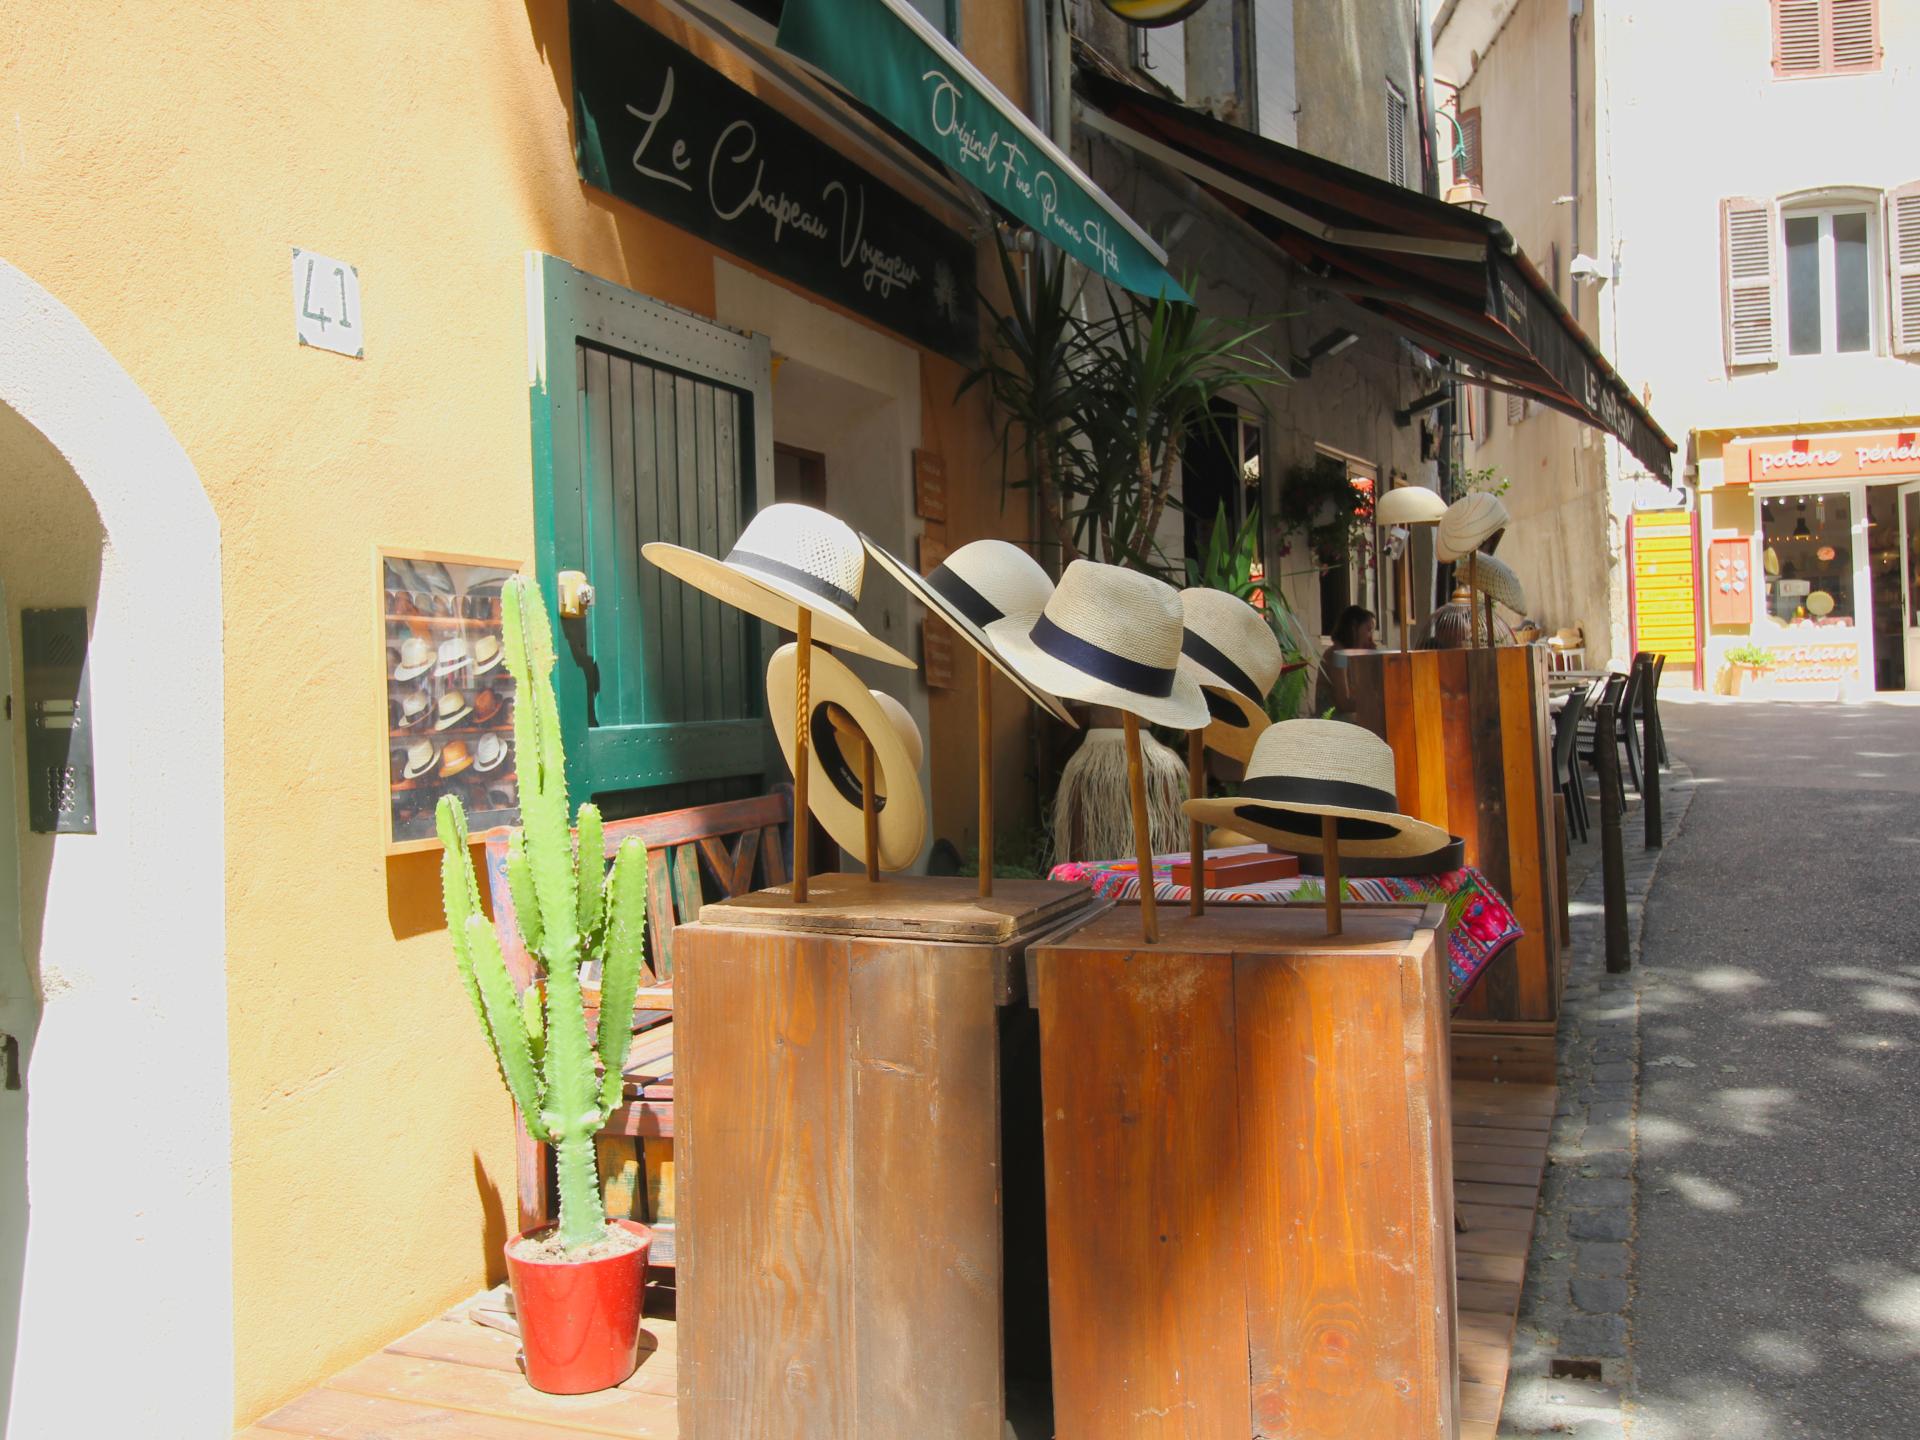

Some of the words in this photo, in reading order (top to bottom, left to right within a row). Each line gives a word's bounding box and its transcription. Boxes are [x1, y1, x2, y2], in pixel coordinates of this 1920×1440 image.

[626, 66, 692, 191] Le
[708, 119, 828, 243] Chapeau
[822, 180, 920, 299] Voyageur
[922, 70, 998, 174] Original
[1001, 140, 1033, 198] Fine
[1034, 171, 1082, 244] Panama
[1083, 220, 1120, 274] Hats
[302, 259, 352, 333] 41
